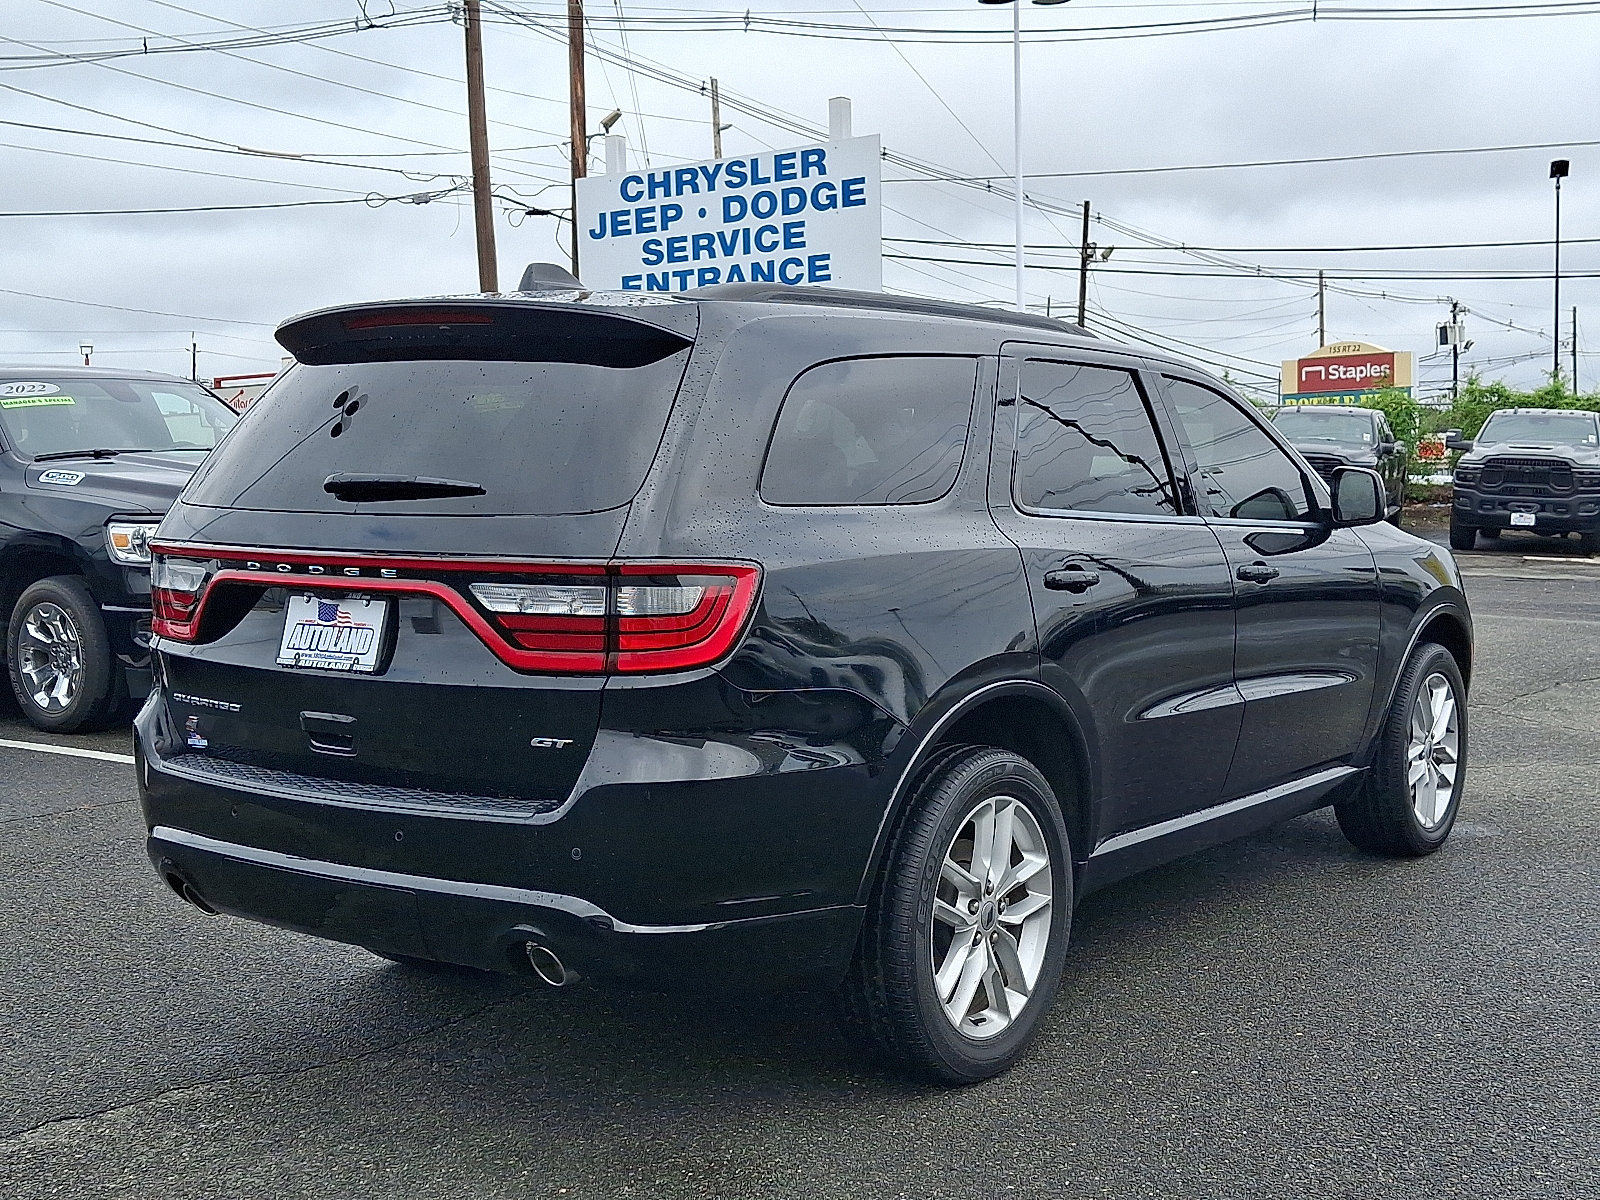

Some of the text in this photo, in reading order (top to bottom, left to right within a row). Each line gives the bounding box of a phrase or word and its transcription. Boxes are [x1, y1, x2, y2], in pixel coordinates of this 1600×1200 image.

[620, 148, 827, 203] CHRYSLER
[588, 176, 867, 240] JEEP DODGE
[641, 220, 807, 266] SERVICE
[621, 253, 832, 292] ENTRANCE
[1342, 345, 1351, 353] RT
[1352, 344, 1361, 352] 22
[1328, 362, 1390, 382] Staples
[4, 384, 47, 394] 2022
[246, 561, 397, 578] DODGE
[286, 623, 375, 656] AUTOLAND
[298, 659, 351, 670] AUTOLAND
[530, 737, 573, 749] GT
